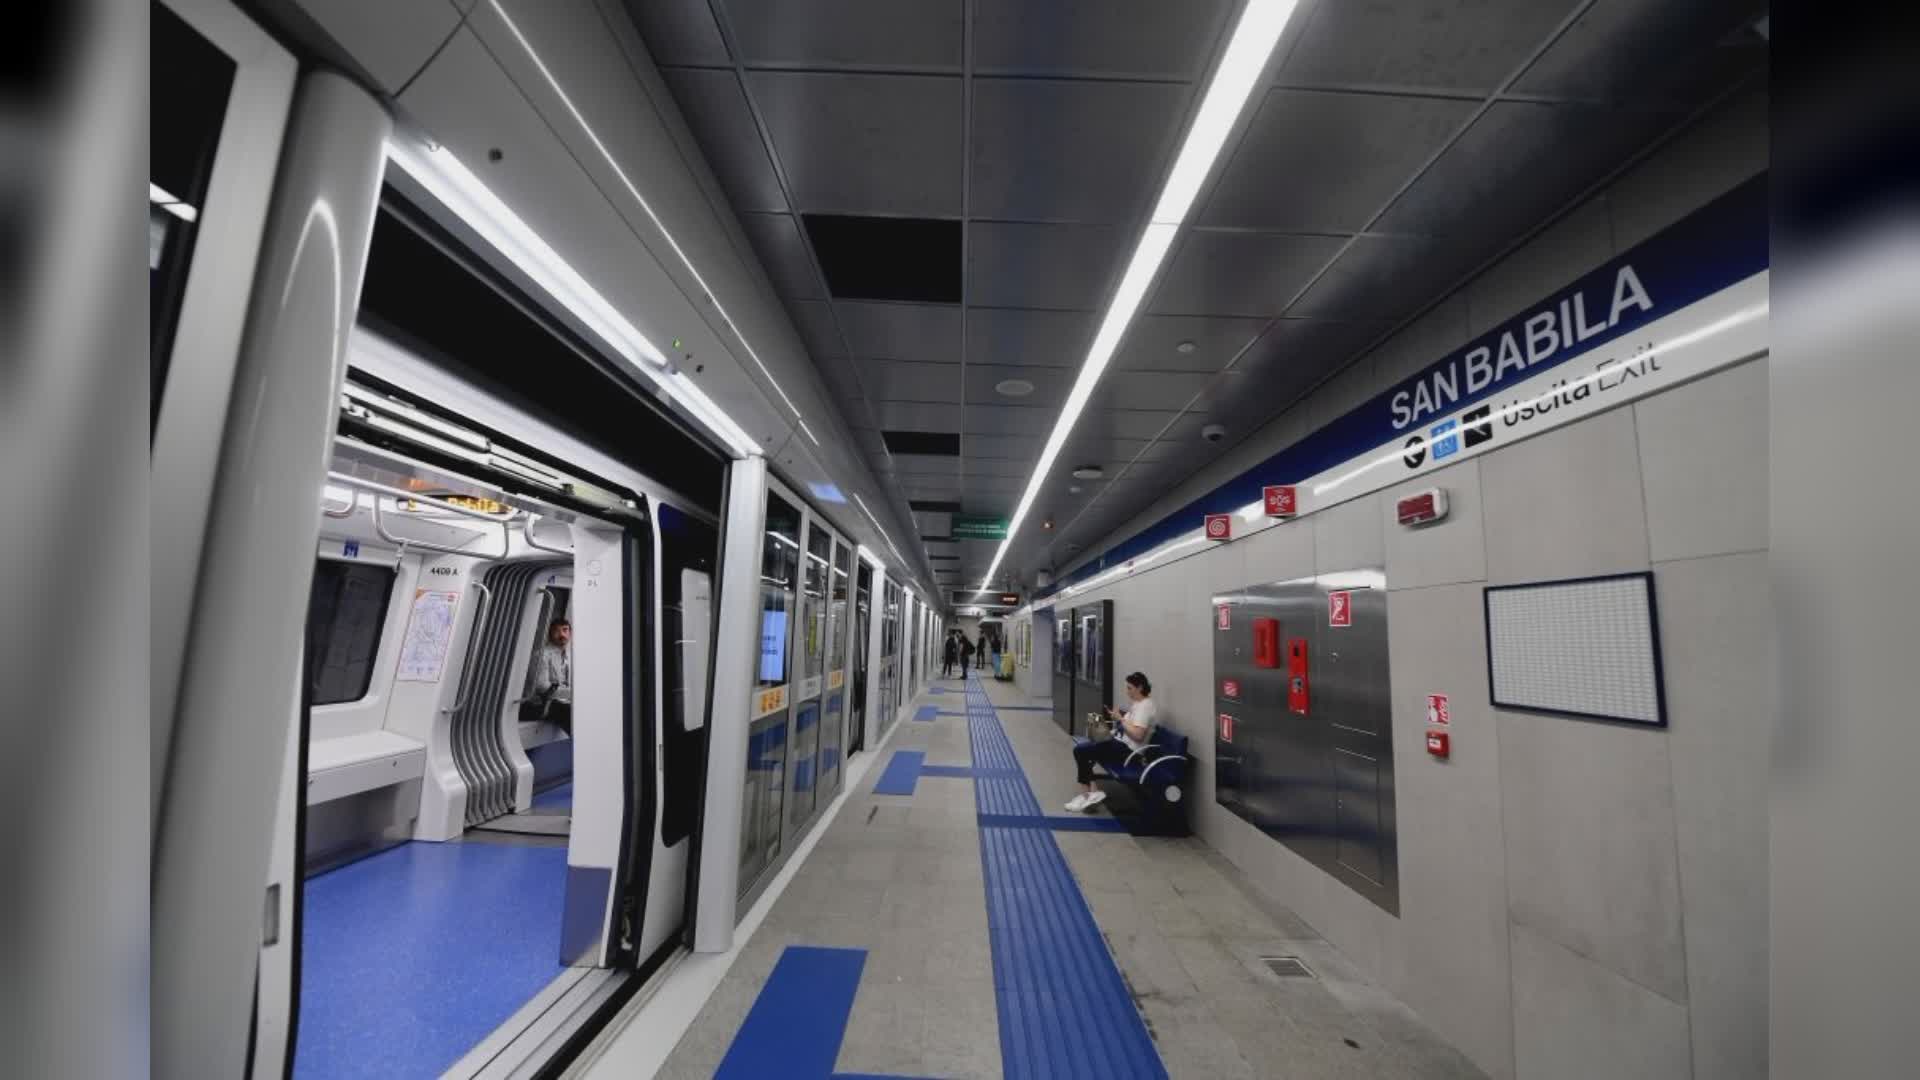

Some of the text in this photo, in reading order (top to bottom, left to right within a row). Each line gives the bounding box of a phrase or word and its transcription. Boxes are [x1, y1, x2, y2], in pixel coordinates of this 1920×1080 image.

[1391, 264, 1654, 430] SAN BABILA
[1502, 342, 1663, 427] Uscita Exit
